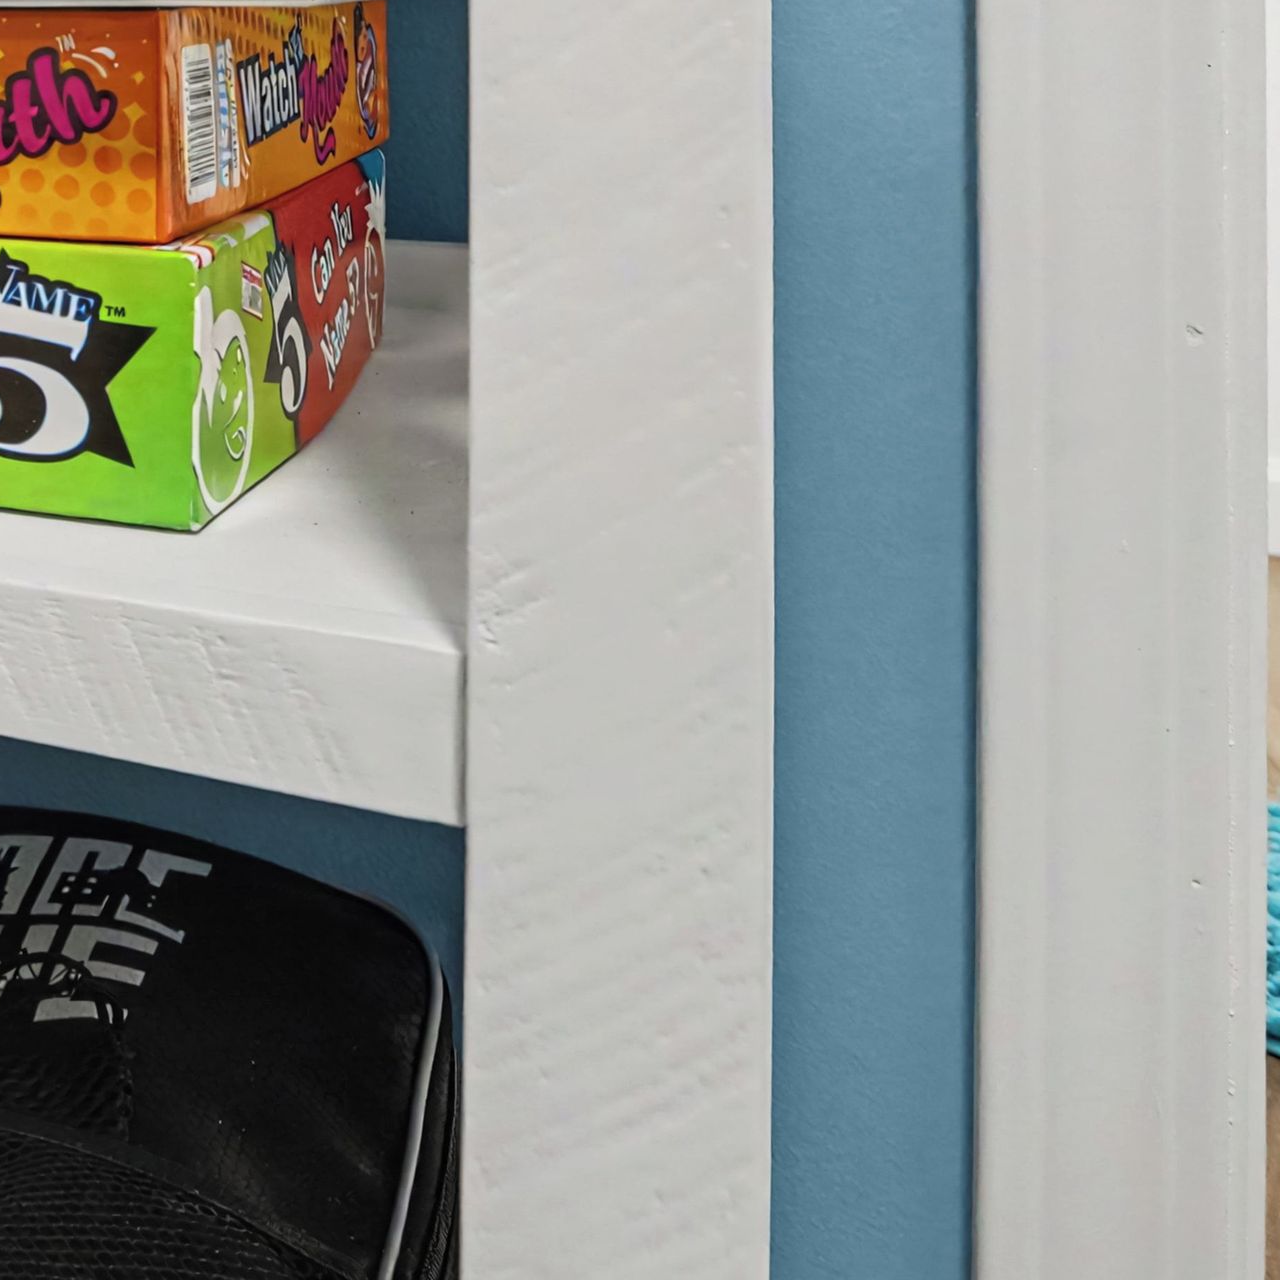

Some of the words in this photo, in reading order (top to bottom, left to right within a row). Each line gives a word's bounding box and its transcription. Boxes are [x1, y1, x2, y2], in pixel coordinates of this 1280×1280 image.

[238, 40, 300, 146] Watch
[298, 16, 348, 166] Mouth
[104, 305, 127, 318] TM
[311, 238, 335, 305] Can
[271, 264, 308, 414] 5
